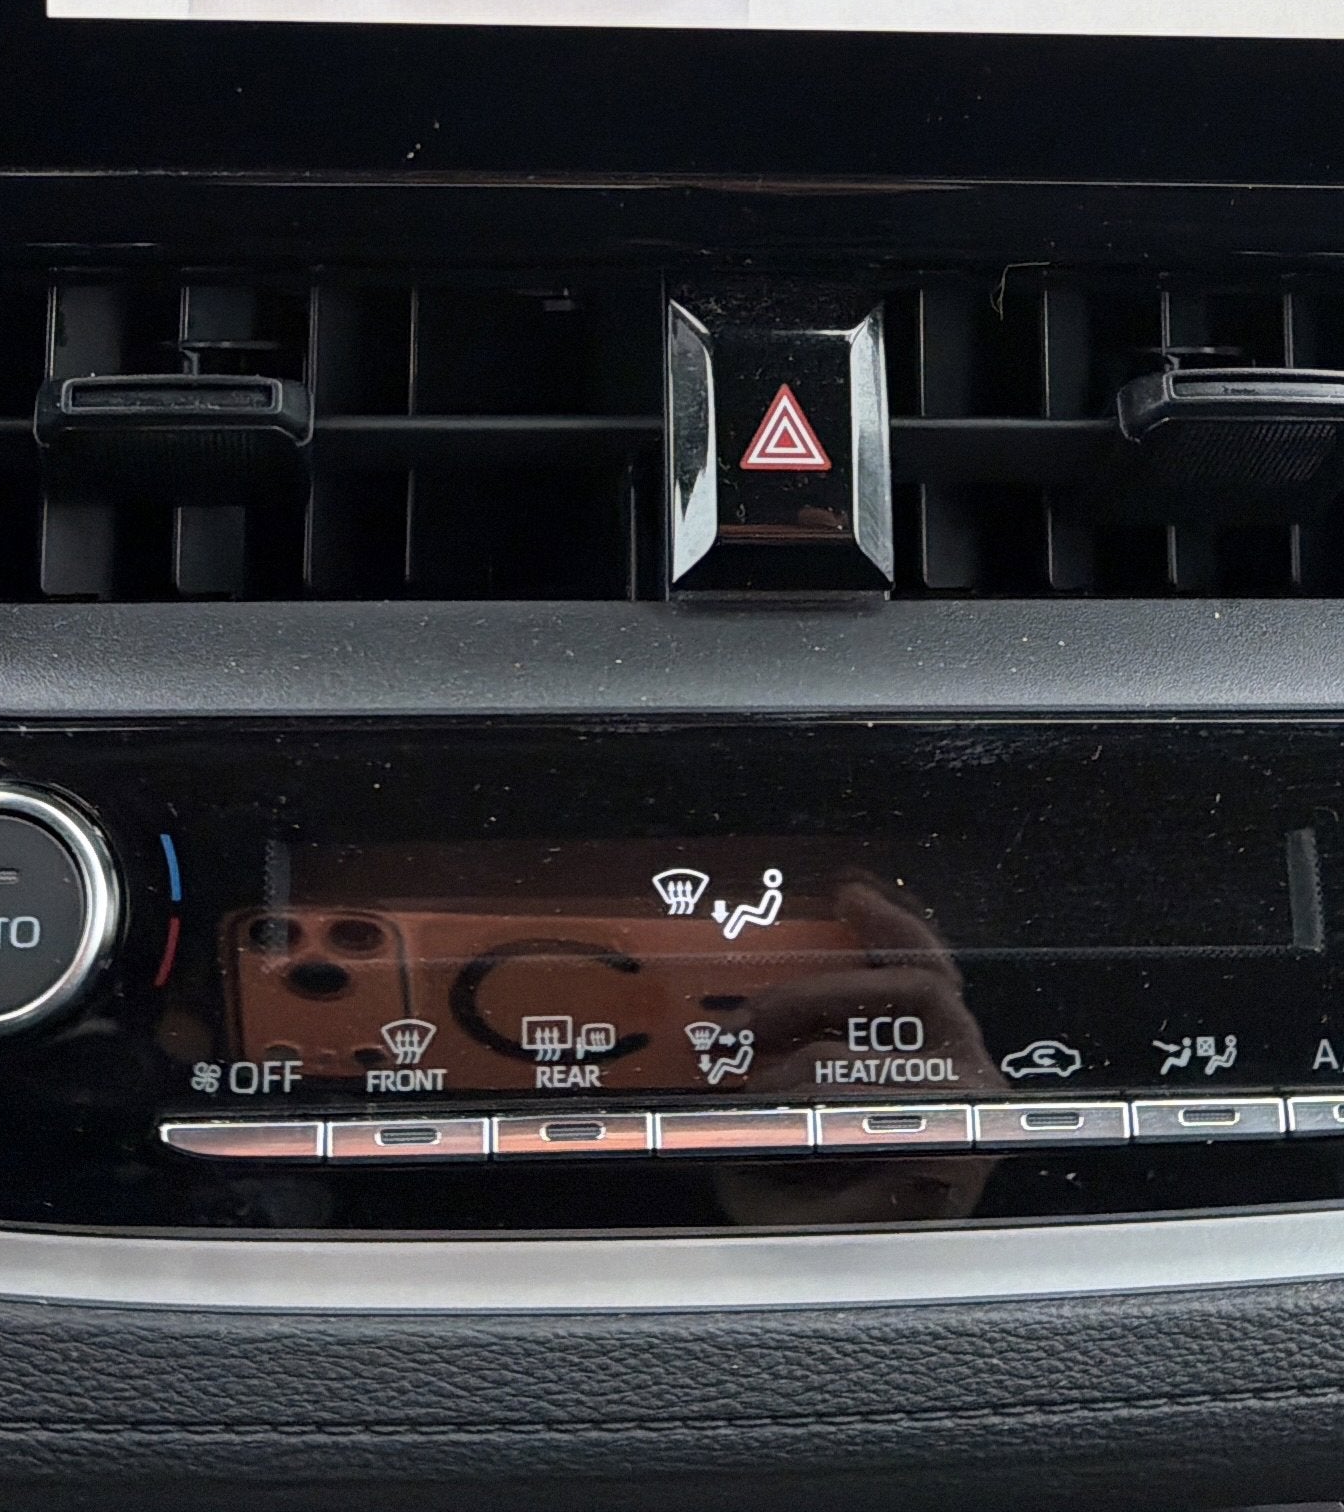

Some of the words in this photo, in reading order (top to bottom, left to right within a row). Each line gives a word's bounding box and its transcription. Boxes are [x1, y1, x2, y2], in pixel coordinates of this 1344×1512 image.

[848, 1017, 923, 1051] ECO
[230, 1061, 304, 1094] OFF
[367, 1069, 447, 1092] FRONT
[536, 1065, 602, 1088] REAR
[816, 1058, 959, 1083] HEAT/COOL
